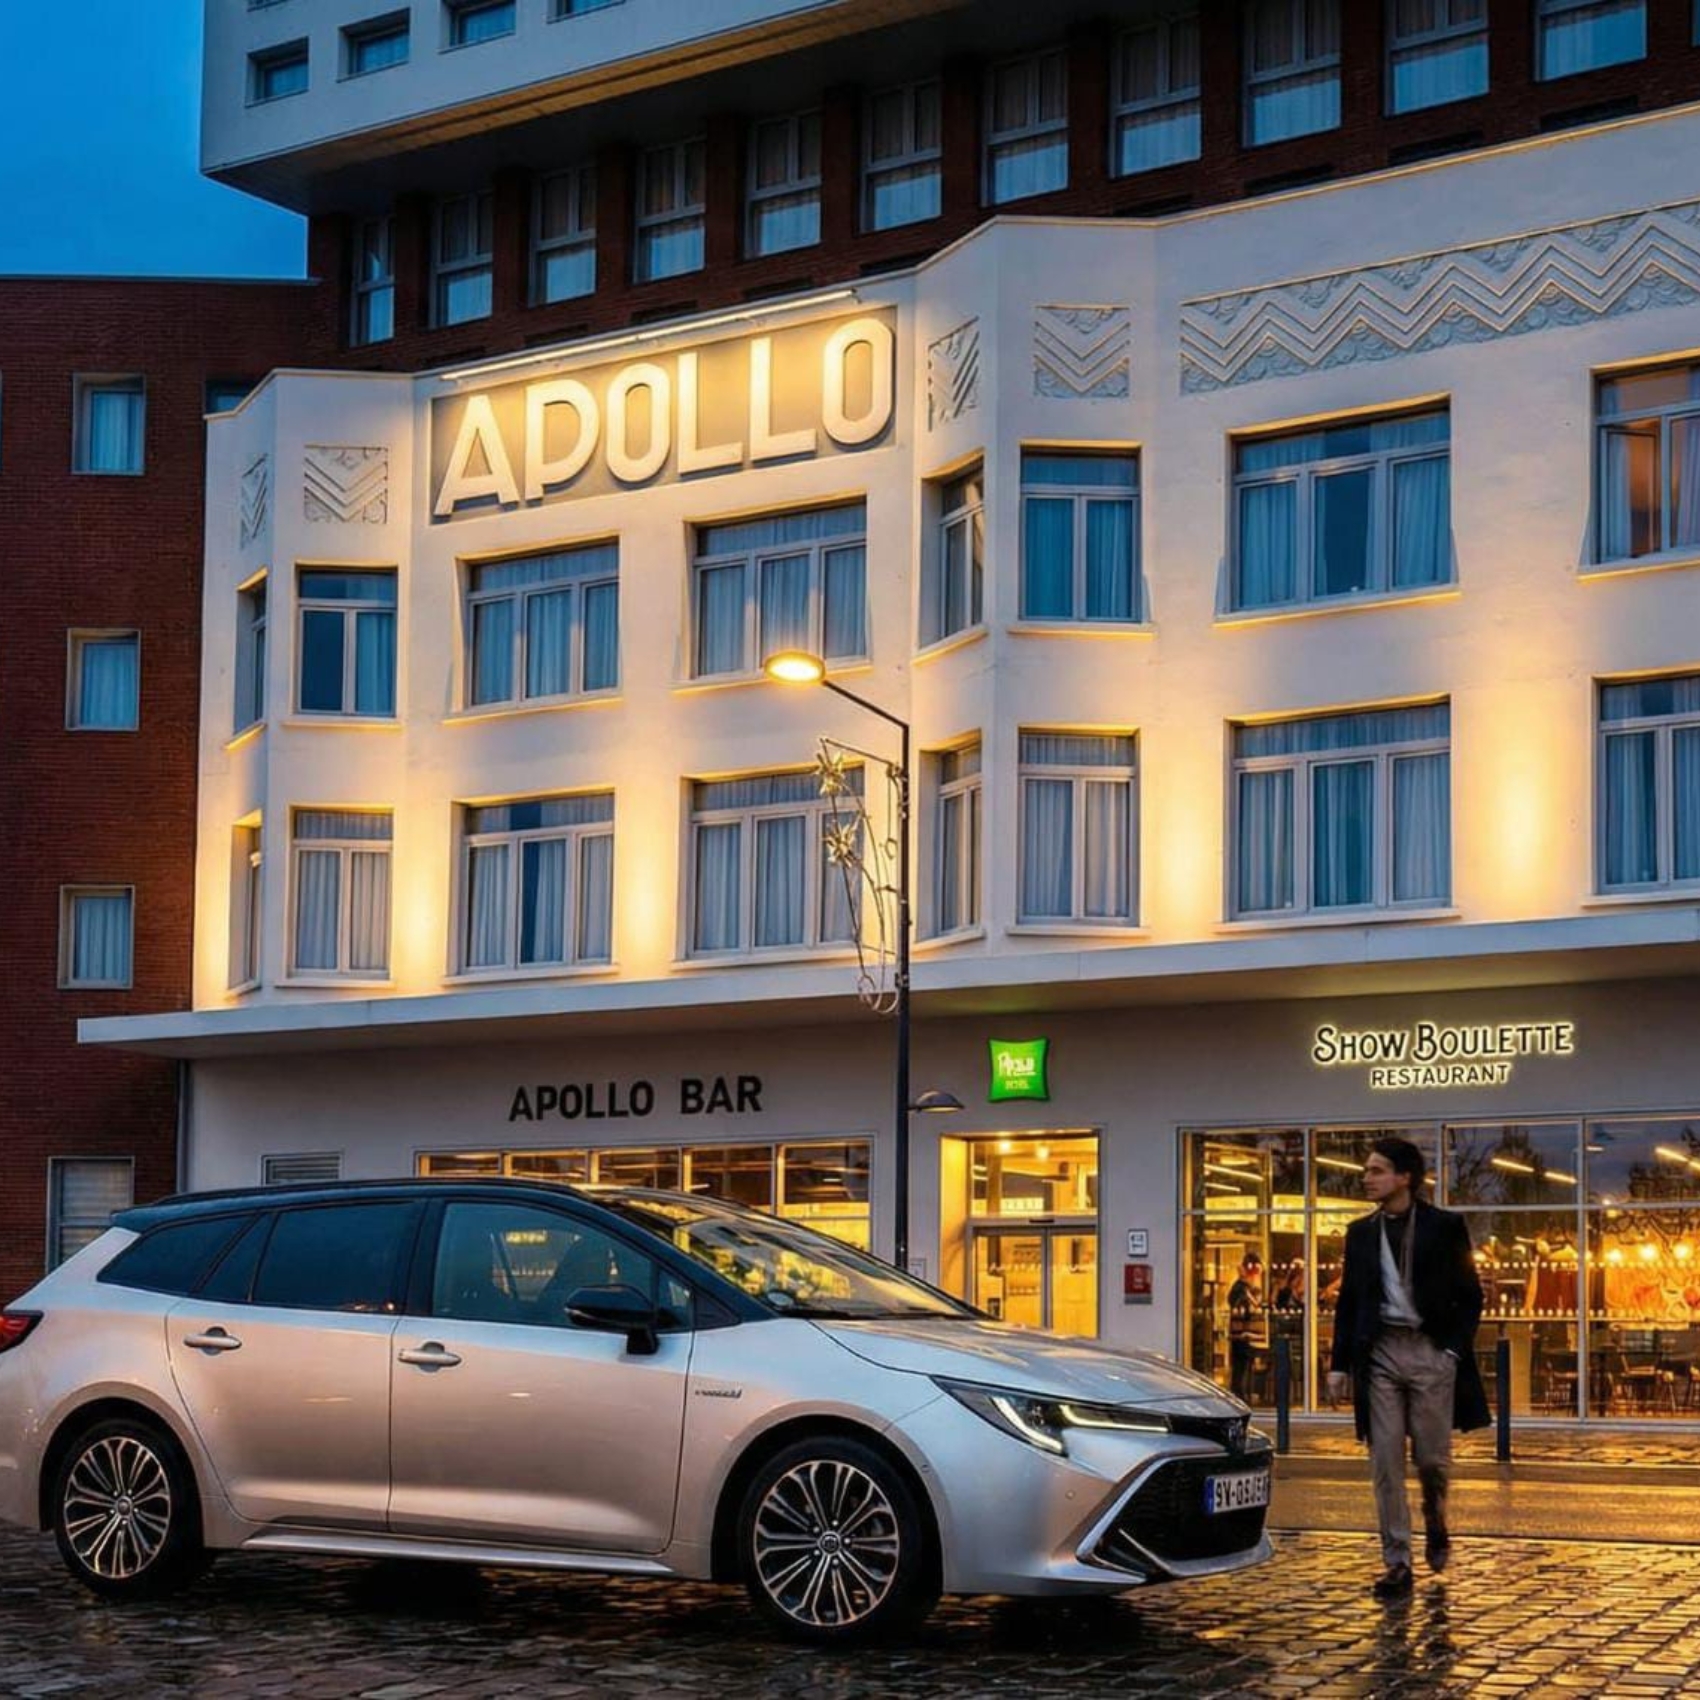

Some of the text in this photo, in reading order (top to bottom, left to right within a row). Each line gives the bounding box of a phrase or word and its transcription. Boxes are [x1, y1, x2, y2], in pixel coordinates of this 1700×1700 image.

[433, 318, 893, 517] APOLLO
[509, 1075, 763, 1121] APOLLO BAR
[1370, 1064, 1511, 1088] RESTAURANT
